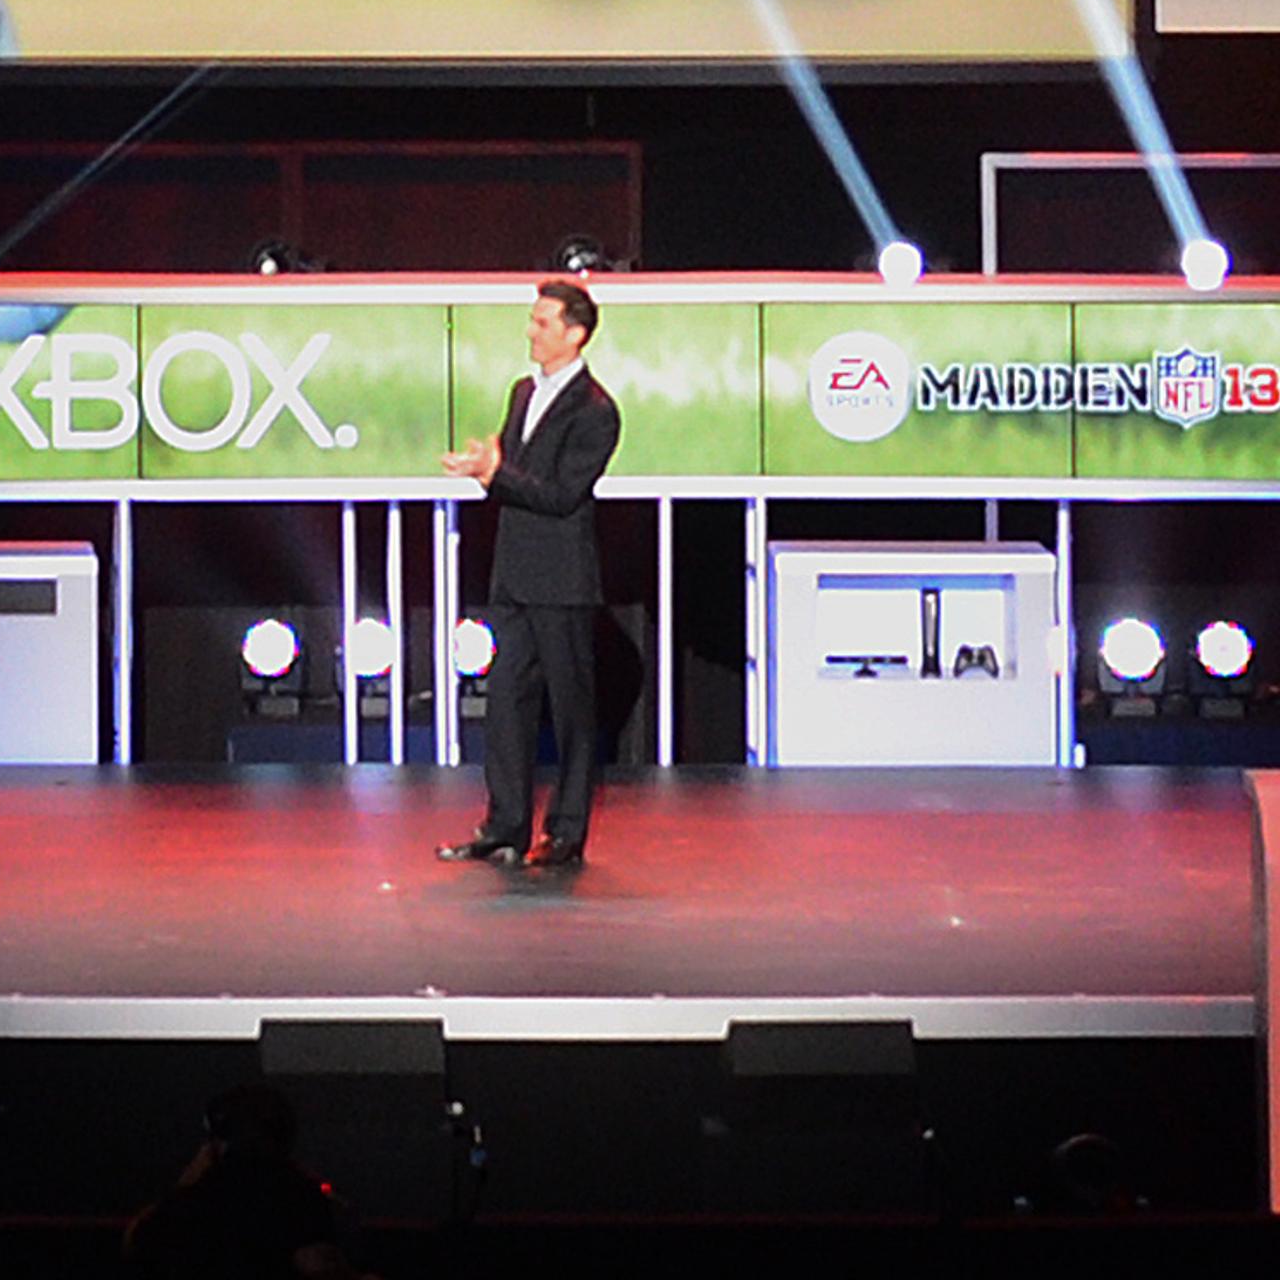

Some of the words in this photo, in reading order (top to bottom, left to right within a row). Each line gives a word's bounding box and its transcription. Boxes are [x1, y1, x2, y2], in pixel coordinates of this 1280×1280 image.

[829, 358, 891, 391] EA
[920, 366, 1149, 408] MADDEN
[1164, 380, 1212, 413] NFL
[1224, 367, 1280, 408] 13
